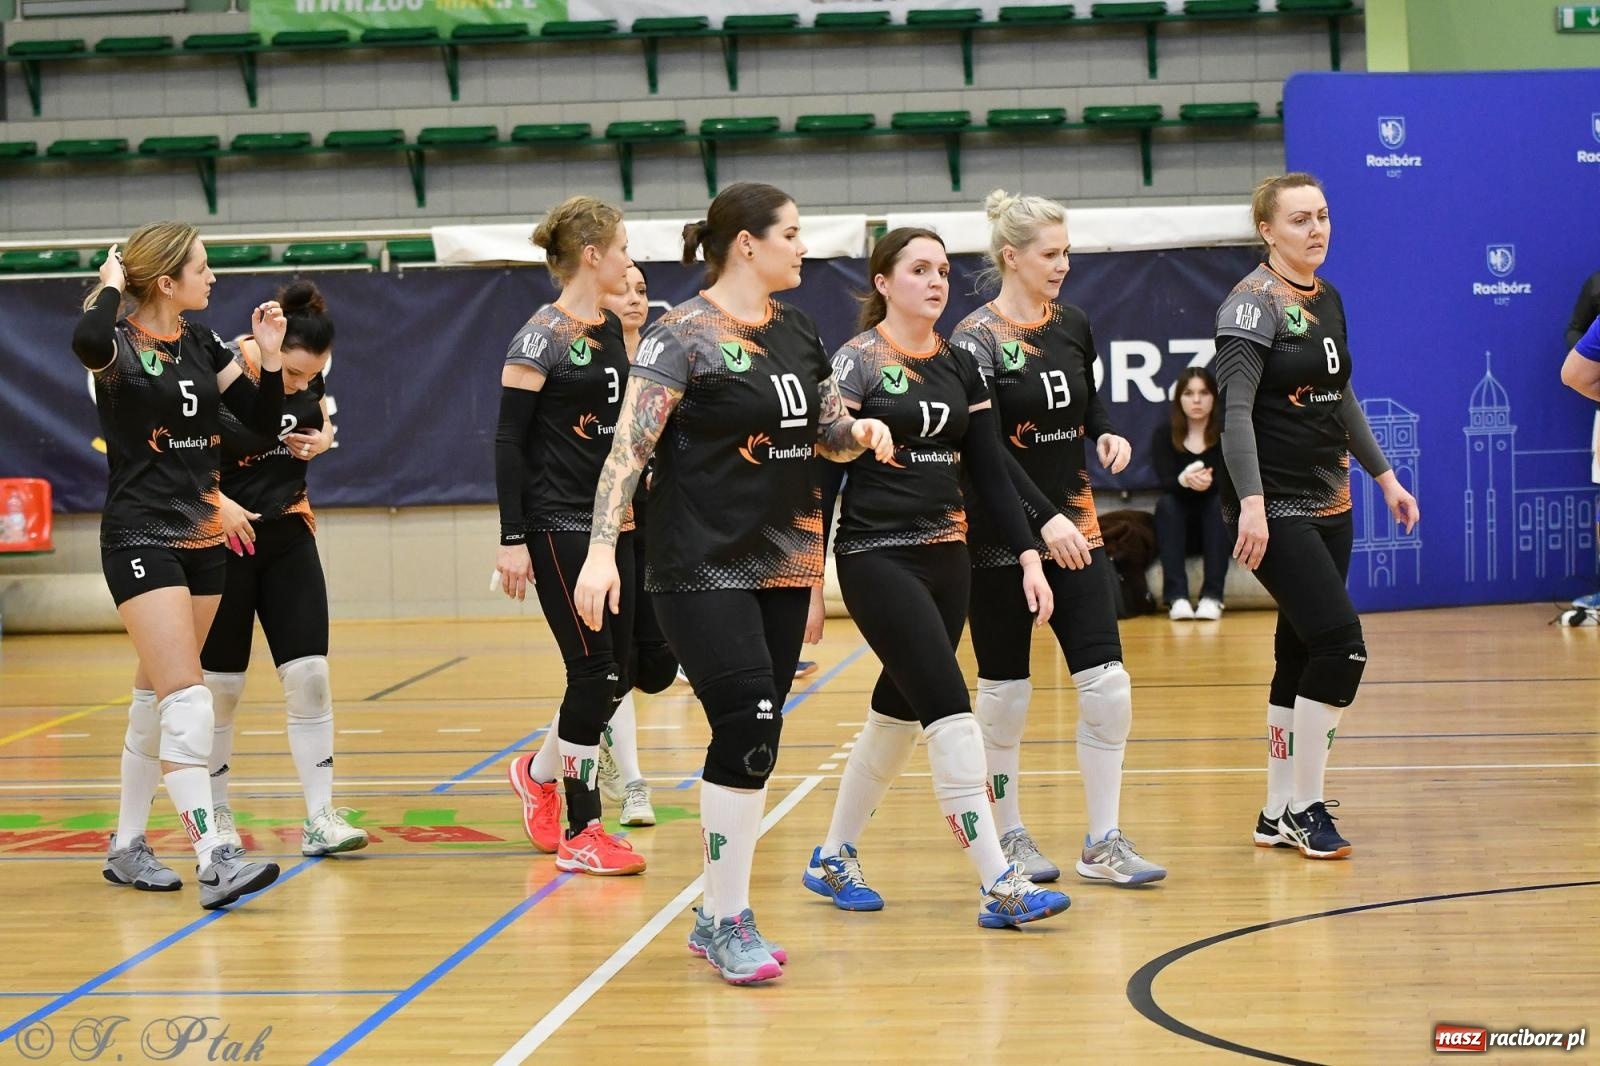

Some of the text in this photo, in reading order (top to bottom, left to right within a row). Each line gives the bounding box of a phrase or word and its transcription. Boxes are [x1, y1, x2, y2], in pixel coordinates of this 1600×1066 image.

[1366, 154, 1422, 167] Racibórz
[1472, 281, 1532, 295] Racibórz
[1323, 337, 1340, 374] 8
[604, 367, 620, 403] 3
[770, 373, 808, 417] 10
[1039, 370, 1071, 410] 13
[178, 380, 198, 417] 5
[277, 413, 298, 441] 2
[919, 400, 950, 438] 17
[169, 435, 208, 450] Fundacja
[1035, 427, 1077, 443] Fundacja
[768, 443, 812, 460] Fundacja
[910, 451, 953, 466] Fundacja
[130, 557, 146, 579] 5
